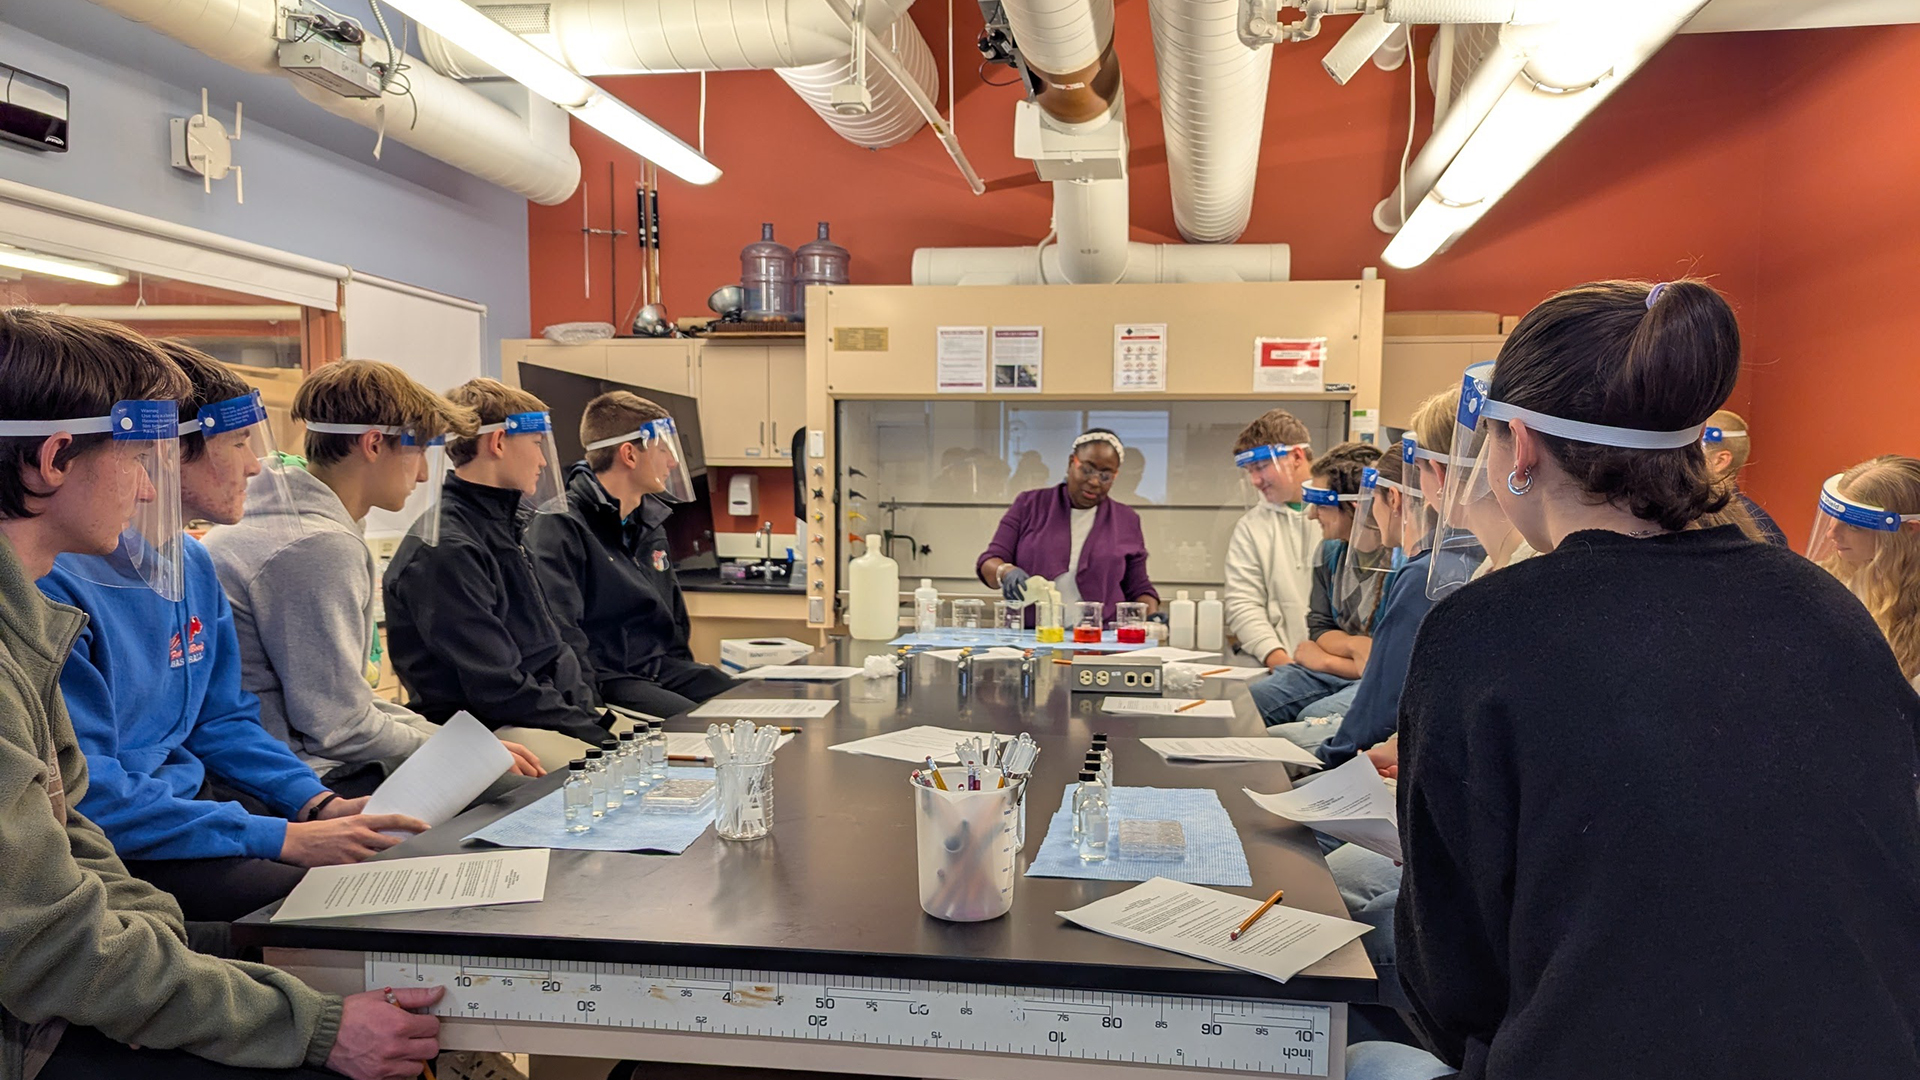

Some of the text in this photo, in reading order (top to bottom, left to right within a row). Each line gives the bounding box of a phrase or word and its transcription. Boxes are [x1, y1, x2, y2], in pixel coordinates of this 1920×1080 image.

[418, 974, 424, 982] 5
[454, 976, 472, 987] 10
[541, 981, 561, 992] 20
[815, 997, 835, 1009] 50
[960, 1007, 973, 1015] 65
[1057, 1014, 1069, 1022] 75
[1102, 1017, 1123, 1029] 80
[1155, 1020, 1168, 1029] 85
[1201, 1023, 1222, 1036] 90
[1255, 1028, 1269, 1036] 95
[577, 1000, 596, 1012] 30
[808, 1015, 828, 1026] 20
[1048, 1031, 1067, 1043] 10
[1282, 1047, 1311, 1061] inch
